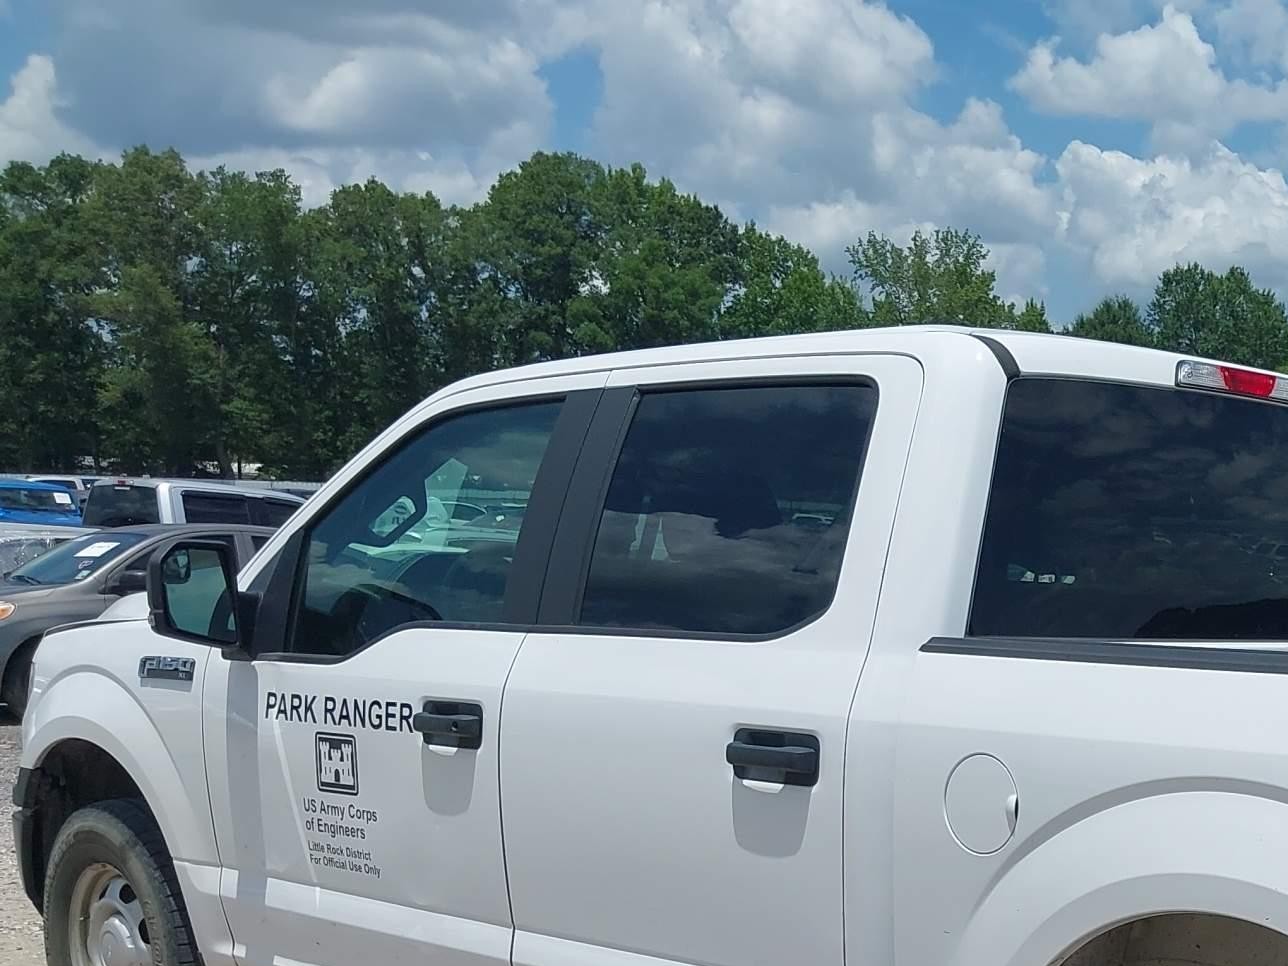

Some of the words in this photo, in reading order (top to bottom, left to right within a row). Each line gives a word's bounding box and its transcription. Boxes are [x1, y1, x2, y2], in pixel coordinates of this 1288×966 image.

[265, 692, 317, 724] PARK
[324, 696, 414, 733] RANGER
[303, 797, 317, 813] US
[320, 800, 345, 821] Army
[348, 804, 378, 825] Corps
[305, 817, 315, 831] of
[317, 818, 366, 840] Engineers
[308, 840, 326, 853] Little
[326, 843, 345, 857] Rock
[345, 847, 372, 862] District
[310, 853, 322, 865] For
[322, 856, 348, 870] Official
[348, 860, 362, 873] Use
[364, 863, 381, 879] Only
